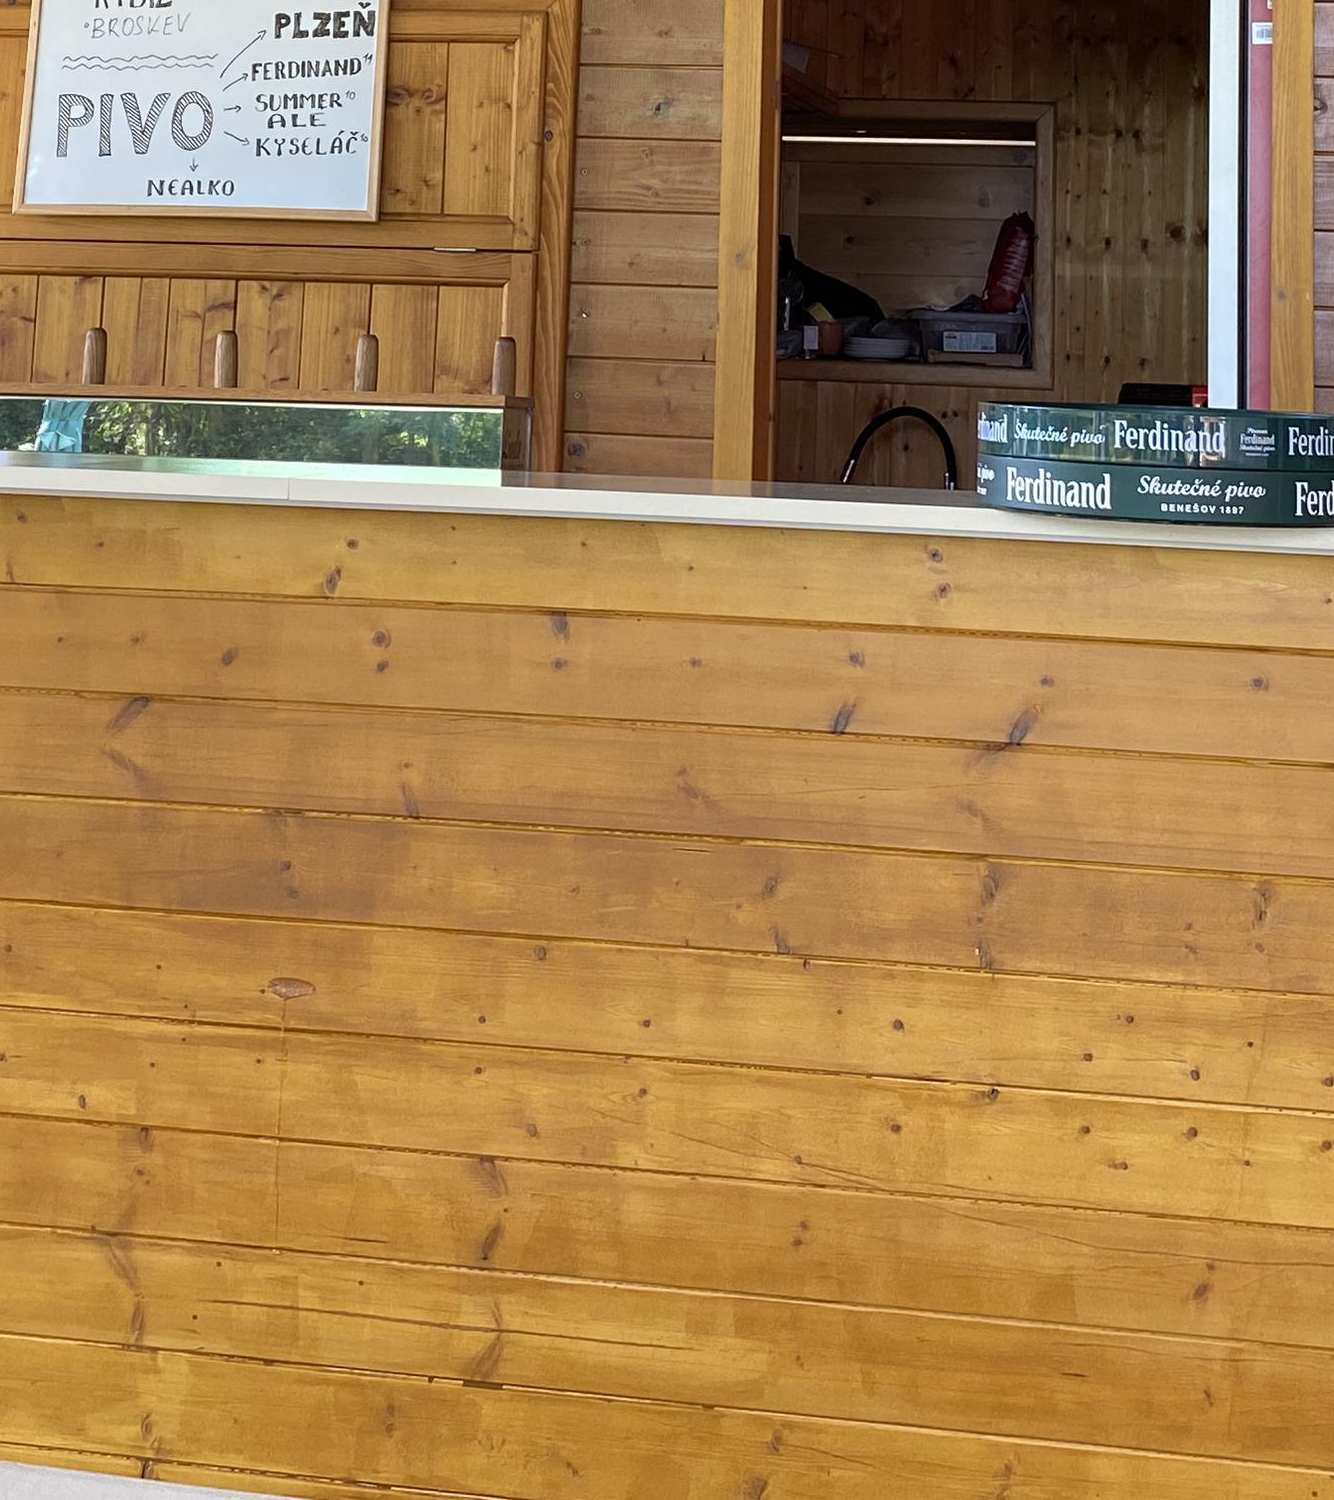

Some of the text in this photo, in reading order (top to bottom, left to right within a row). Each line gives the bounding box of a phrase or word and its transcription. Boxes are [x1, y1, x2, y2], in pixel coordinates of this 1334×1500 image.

[91, 12, 192, 39] BROSKEV
[274, 1, 377, 39] PLZEŇ
[251, 57, 362, 82] FERDINAND
[255, 92, 343, 113] SUMMER
[56, 90, 214, 158] PIVO
[267, 112, 327, 129] ALE
[255, 130, 359, 157] KYSELÁČ
[146, 179, 235, 197] NEALKO
[1013, 420, 1068, 443] Skutečné
[1070, 429, 1106, 447] pivo
[1113, 419, 1226, 454] Ferdinand
[1006, 466, 1112, 510] Ferdinand
[1137, 475, 1222, 497] Skutečné
[1225, 482, 1267, 501] pivo
[1160, 502, 1217, 514] BENEŠOV
